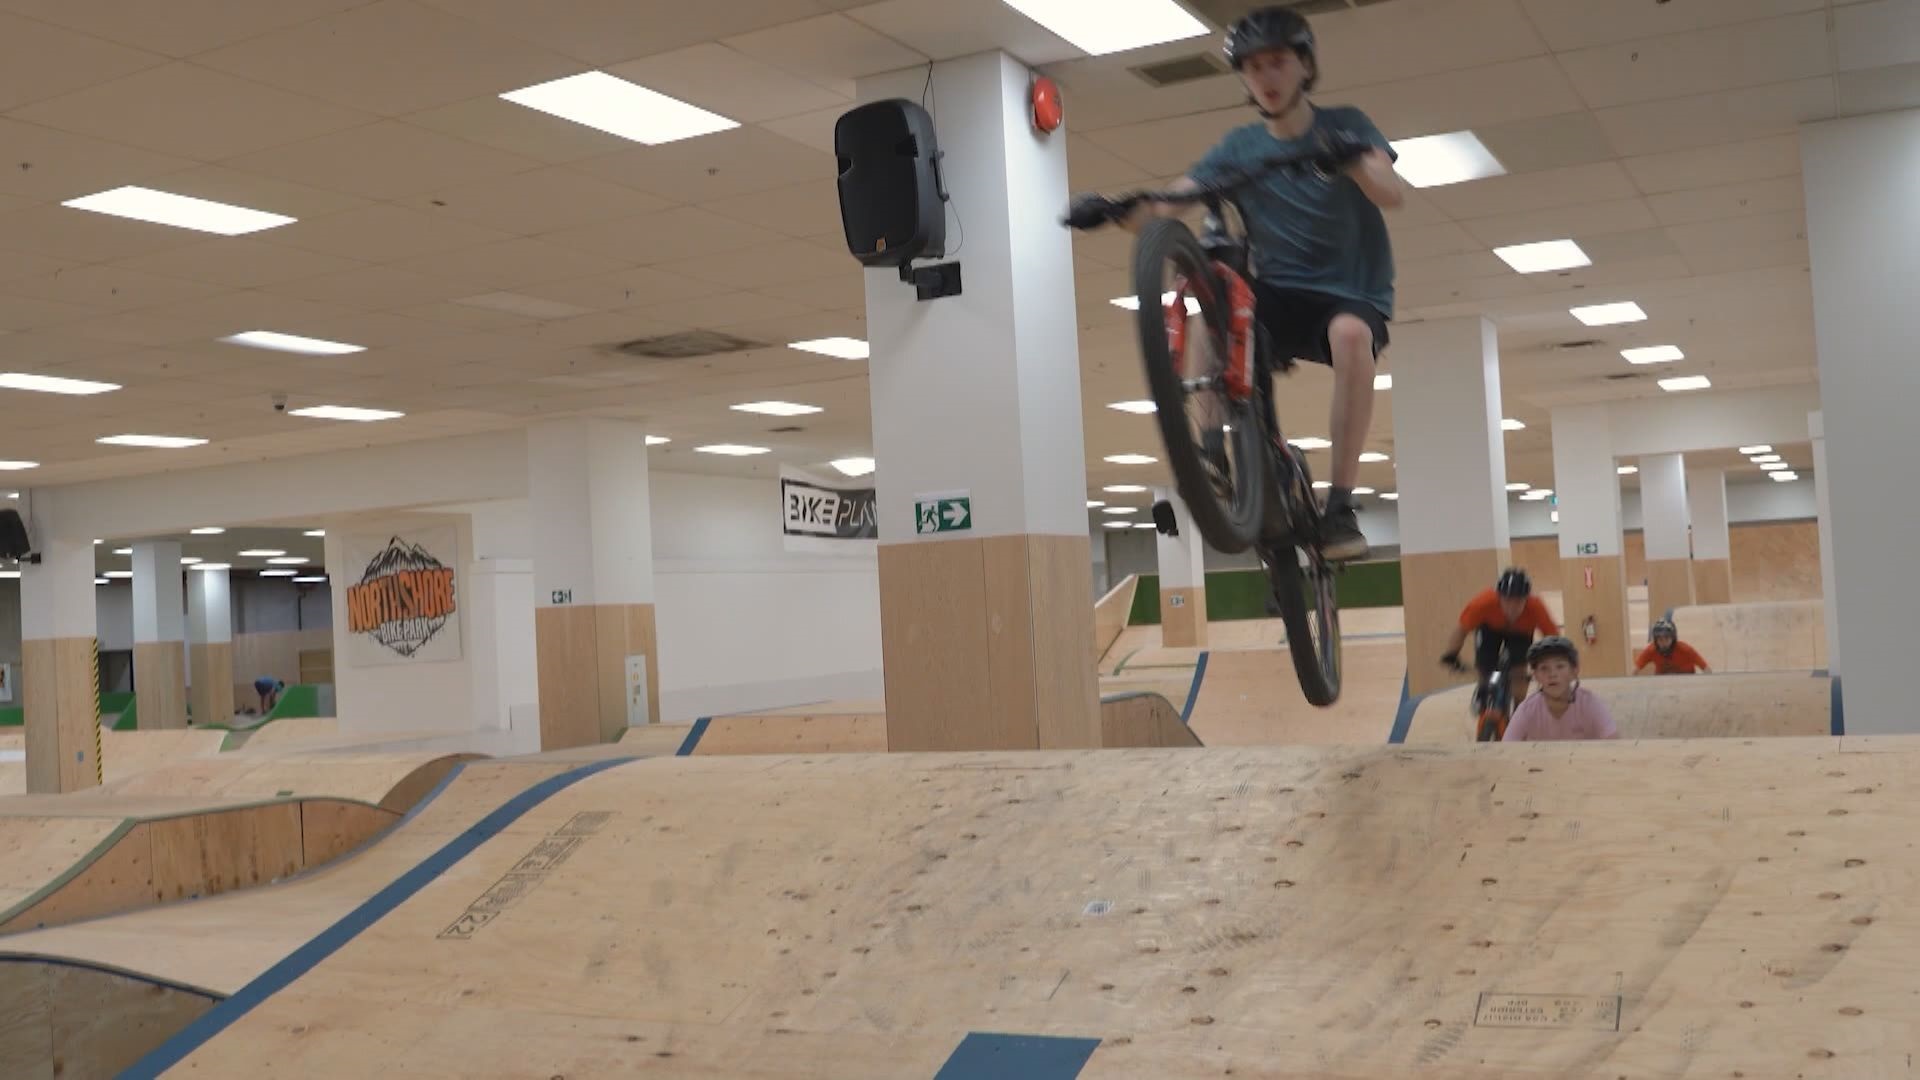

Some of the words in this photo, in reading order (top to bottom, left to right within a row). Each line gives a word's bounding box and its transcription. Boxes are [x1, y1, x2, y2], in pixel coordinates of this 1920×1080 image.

[790, 494, 835, 525] BIKE
[347, 574, 401, 634] NORTH
[398, 567, 456, 622] SHORE
[380, 619, 405, 643] BIKE
[404, 617, 432, 641] PARK
